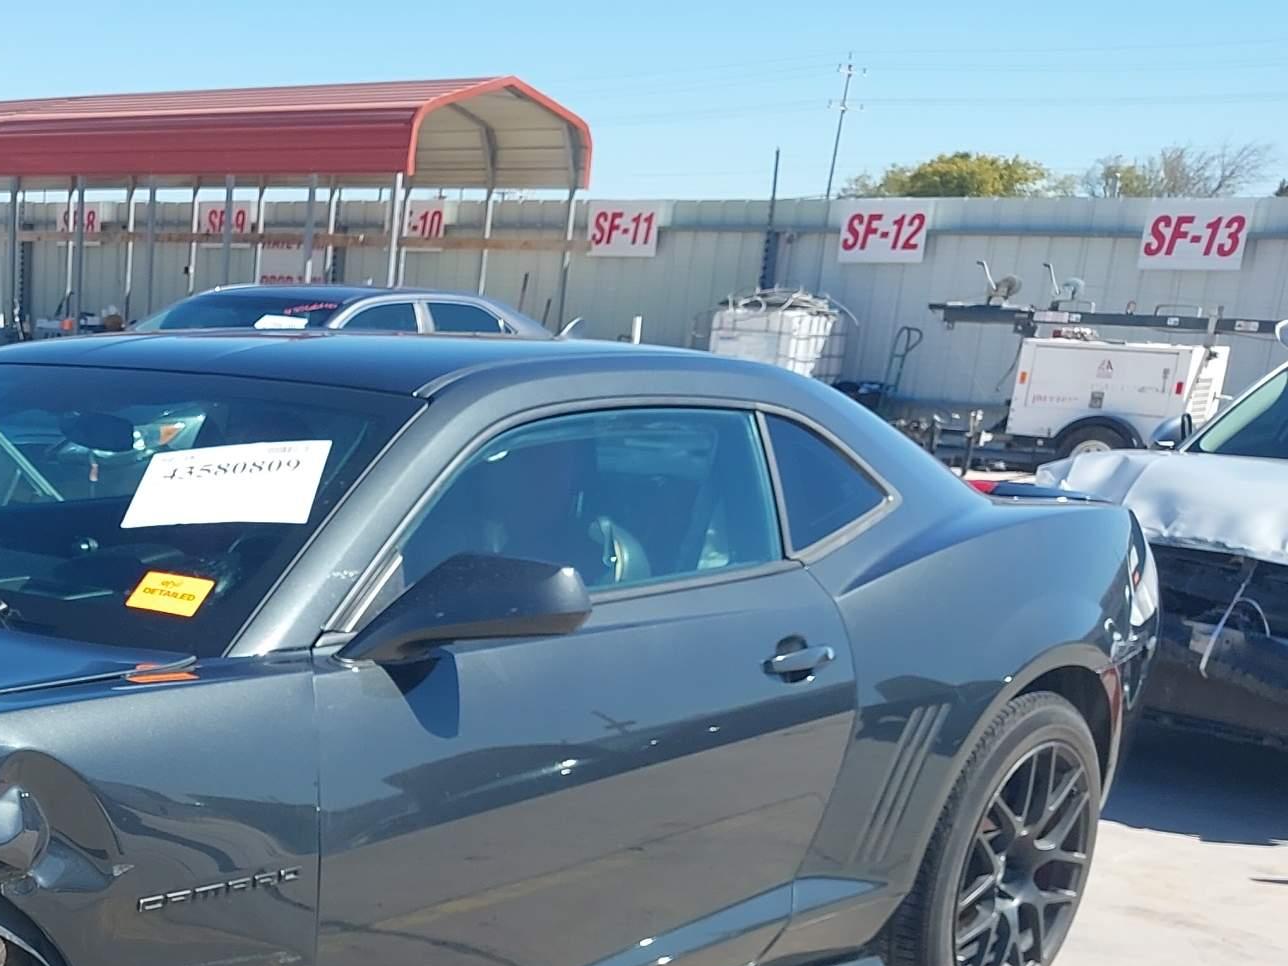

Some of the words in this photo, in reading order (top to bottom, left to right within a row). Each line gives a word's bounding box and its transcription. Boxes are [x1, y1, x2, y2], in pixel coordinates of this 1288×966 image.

[592, 210, 655, 246] SF-11
[841, 212, 926, 252] SF-12
[1143, 215, 1247, 258] SF-13
[161, 459, 302, 481] 43580809
